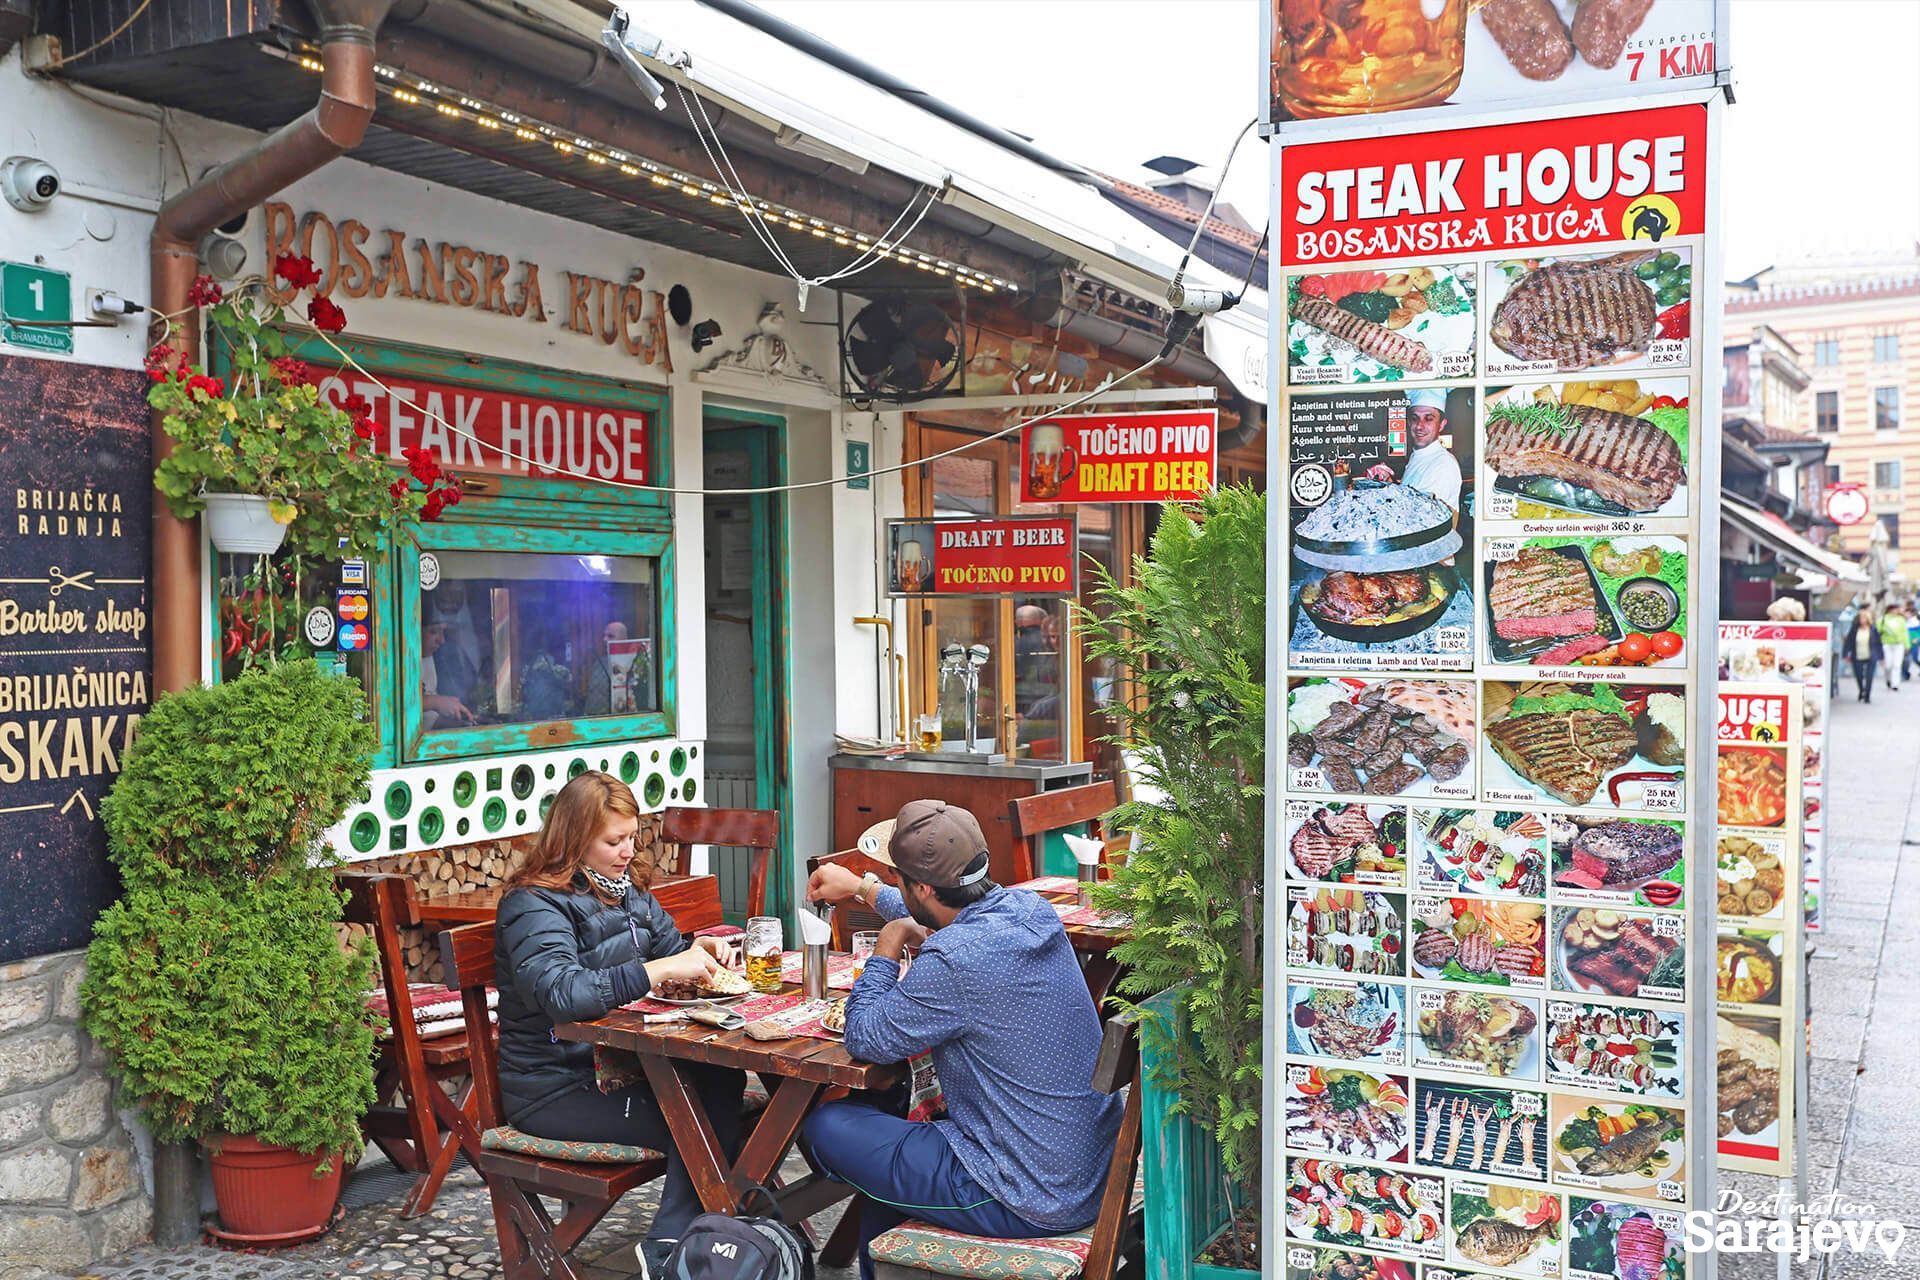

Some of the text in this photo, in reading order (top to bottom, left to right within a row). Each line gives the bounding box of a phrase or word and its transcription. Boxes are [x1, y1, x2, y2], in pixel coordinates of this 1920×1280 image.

[1626, 42, 1713, 81] 7 KM
[1295, 135, 1686, 225] STEAK HOUSE
[1296, 203, 1610, 260] BOSANSKA KUĆA
[263, 201, 547, 323] BOSANSKA
[28, 279, 44, 312] 1
[1665, 343, 1682, 352] KM
[1455, 355, 1470, 363] KM
[1488, 365, 1502, 373] Big
[1291, 401, 1328, 411] Janjetina
[1336, 400, 1365, 409] teletina
[1367, 398, 1390, 409] ispod
[1292, 411, 1374, 422] Lamb and veal roast
[1325, 424, 1346, 432] dana
[1348, 424, 1359, 432] eti
[501, 399, 643, 481] HOUSE
[1078, 423, 1210, 456] TOČENO PIVO
[1291, 437, 1324, 447] Agnello
[1331, 436, 1356, 444] vitello
[1358, 435, 1387, 443] arrosto
[854, 449, 862, 469] 3
[1290, 448, 1316, 463] عجل
[1359, 446, 1378, 463] لحم
[1079, 460, 1209, 493] DRAFT BEER
[16, 487, 122, 513] BRIJAČKA
[18, 514, 122, 537] RADNJA
[1523, 524, 1554, 533] Cowboy
[1556, 523, 1580, 532] sirloin
[1582, 523, 1609, 533] weight
[1632, 523, 1646, 533] gr.
[941, 527, 1065, 548] DRAFT BEER
[1502, 542, 1515, 550] KM
[345, 570, 360, 578] VISA
[941, 563, 1066, 584] TOČENO PIVO
[0, 599, 146, 640] Barber shop
[341, 633, 367, 641] Maestro
[1452, 631, 1466, 639] KM
[1299, 655, 1336, 665] Janjetina
[1343, 656, 1372, 665] teletina
[1377, 656, 1400, 665] Lamb
[1402, 657, 1417, 665] and
[1421, 657, 1438, 666] Veal
[1441, 658, 1461, 666] meat
[1538, 670, 1626, 680] Beef fillet Pepper steak
[0, 666, 147, 713] BRIJAČNICA
[1305, 771, 1319, 779] KM
[1492, 792, 1512, 800] Bone
[1660, 789, 1676, 798] KM
[1427, 899, 1439, 907] KM
[1665, 919, 1678, 927] KM
[1429, 993, 1441, 1001] KM
[1439, 1060, 1462, 1068] Chicken
